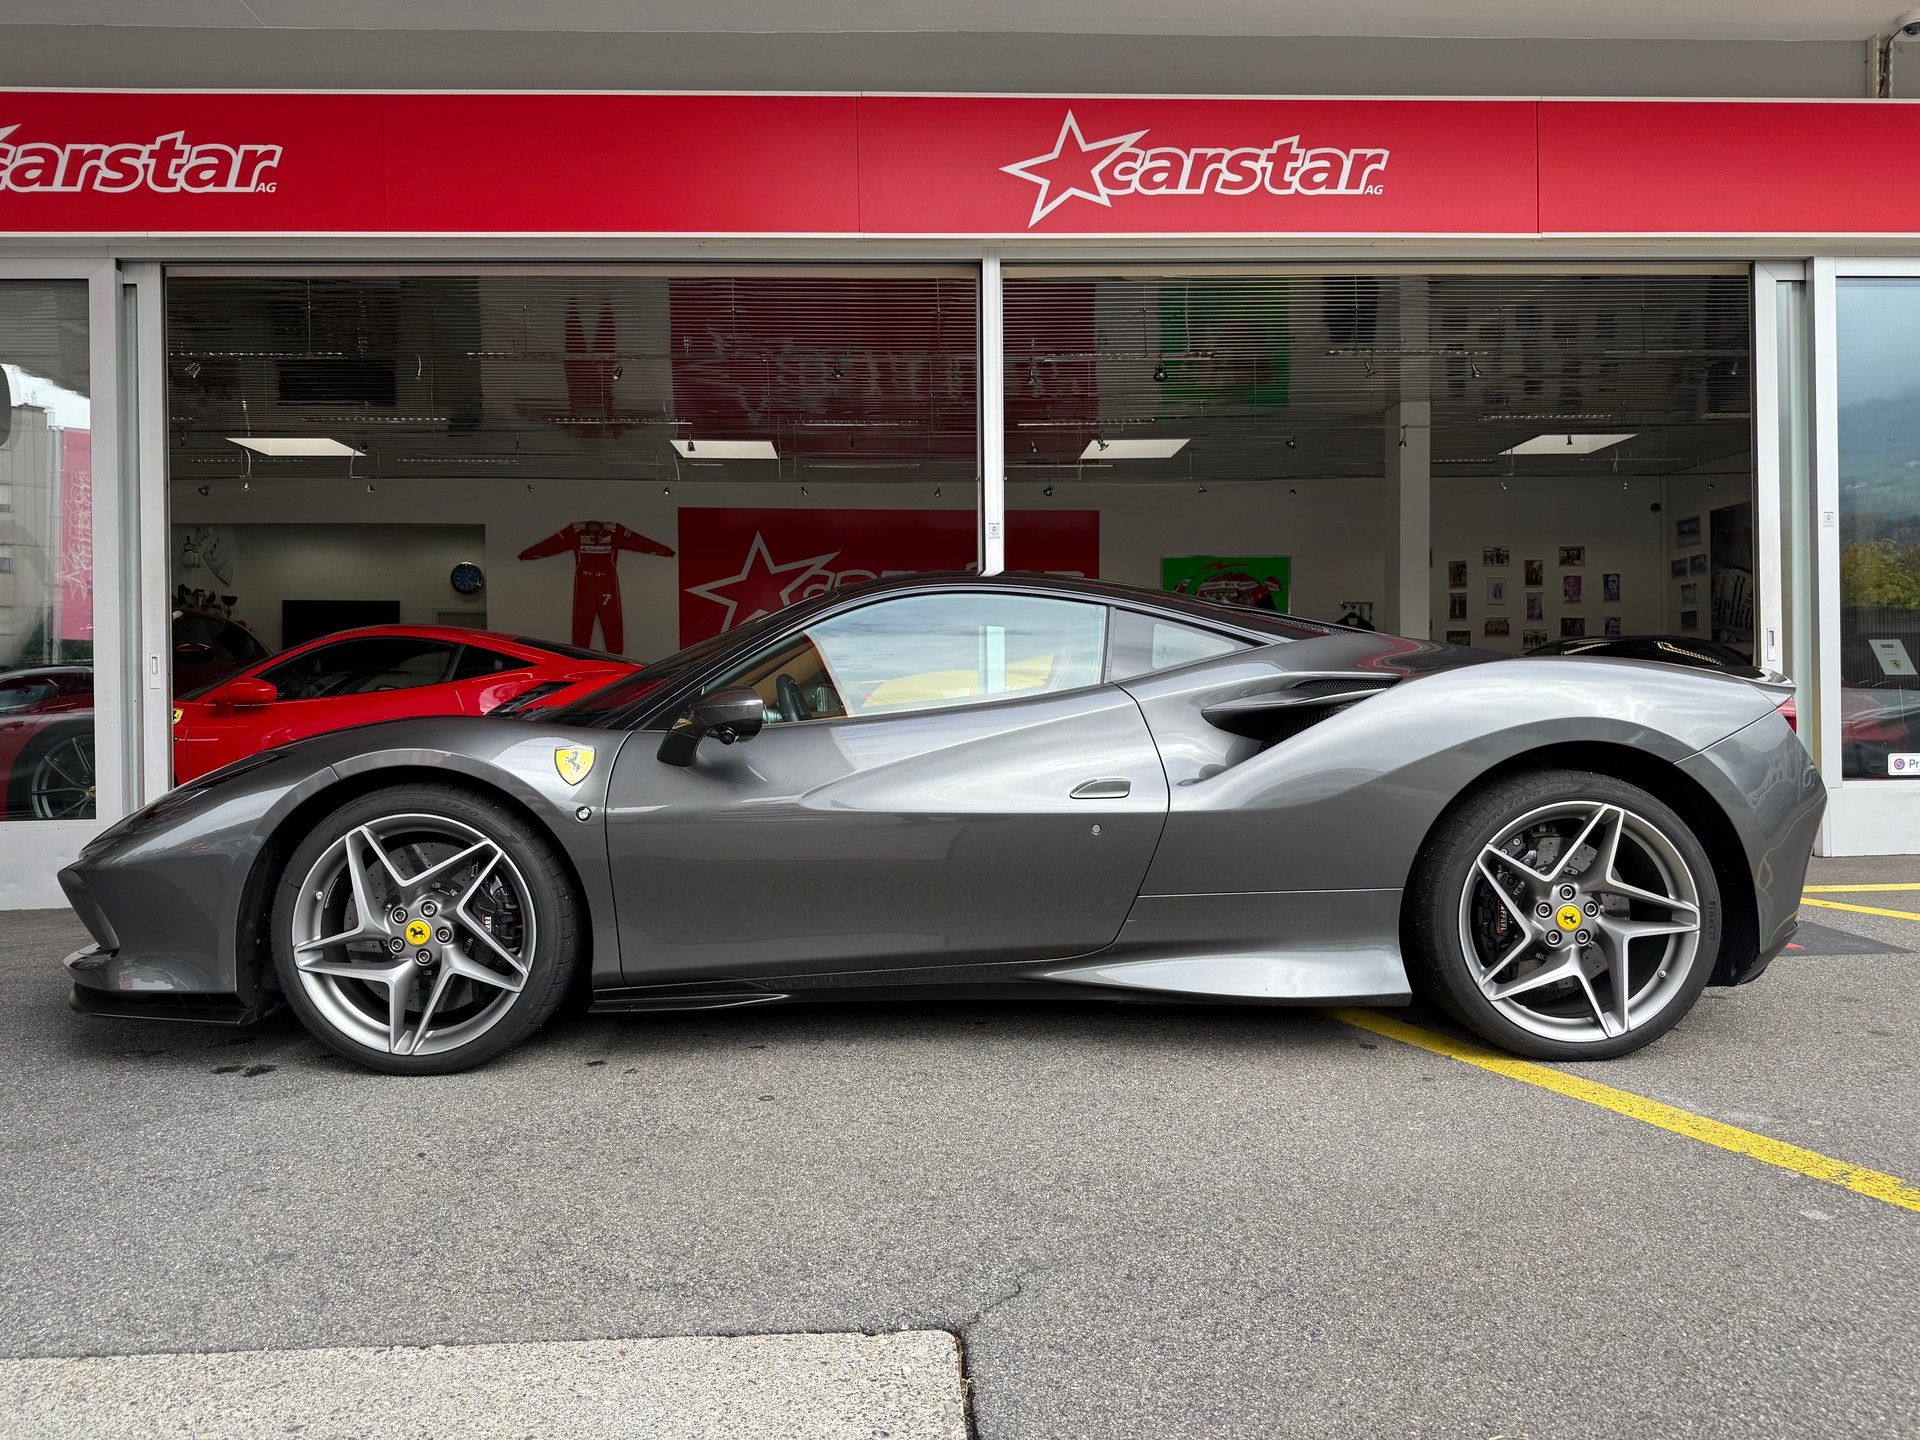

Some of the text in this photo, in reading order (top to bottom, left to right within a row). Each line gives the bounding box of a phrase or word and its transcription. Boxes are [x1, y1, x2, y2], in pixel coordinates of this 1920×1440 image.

[1097, 134, 1390, 195] carstar AG
[255, 182, 277, 193] AG
[602, 593, 612, 605] 7
